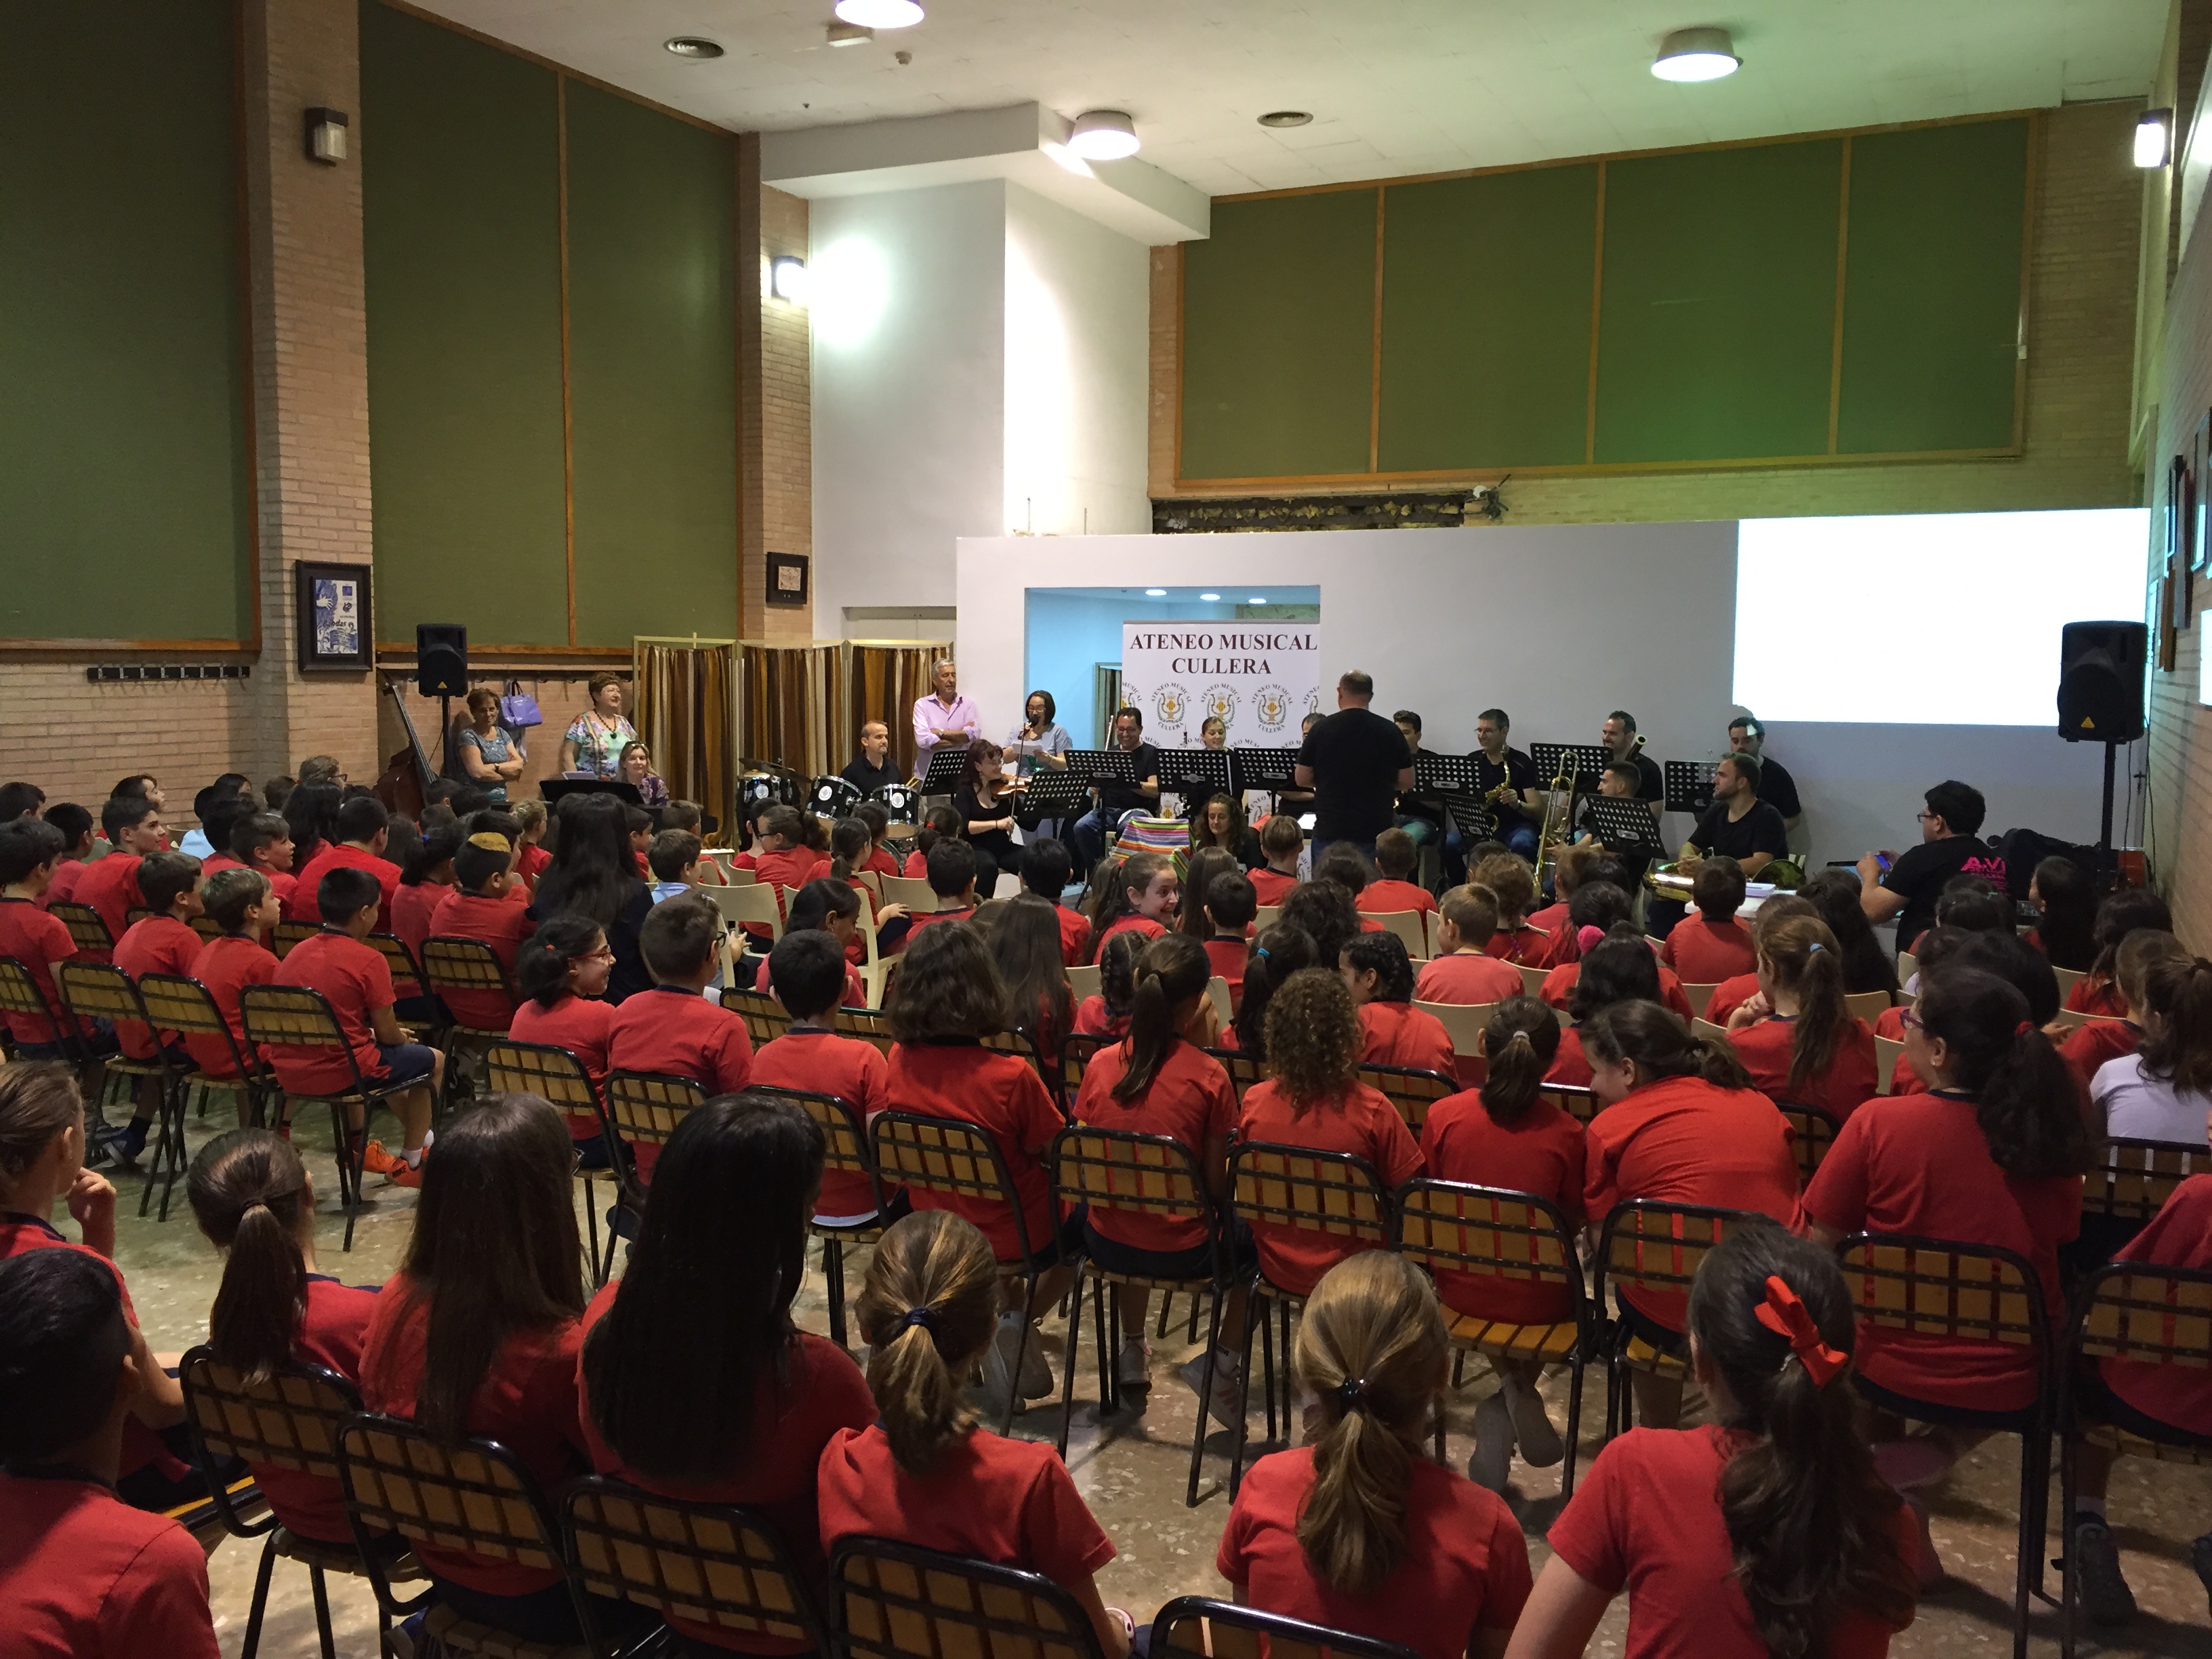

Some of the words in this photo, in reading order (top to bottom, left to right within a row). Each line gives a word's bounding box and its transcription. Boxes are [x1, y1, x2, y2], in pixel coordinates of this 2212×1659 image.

[1130, 634, 1214, 650] ATENEO
[1219, 634, 1317, 651] MUSICAL
[1172, 657, 1271, 674] CULLERA
[1151, 683, 1170, 702] ATENEO
[1170, 682, 1192, 703] MUSICAL
[1200, 684, 1219, 703] ATENEO
[1221, 683, 1242, 703] MUSICAL
[1251, 684, 1271, 704] ATENEO
[1272, 683, 1293, 705] MUSICAL
[1158, 722, 1184, 731] CULLERA
